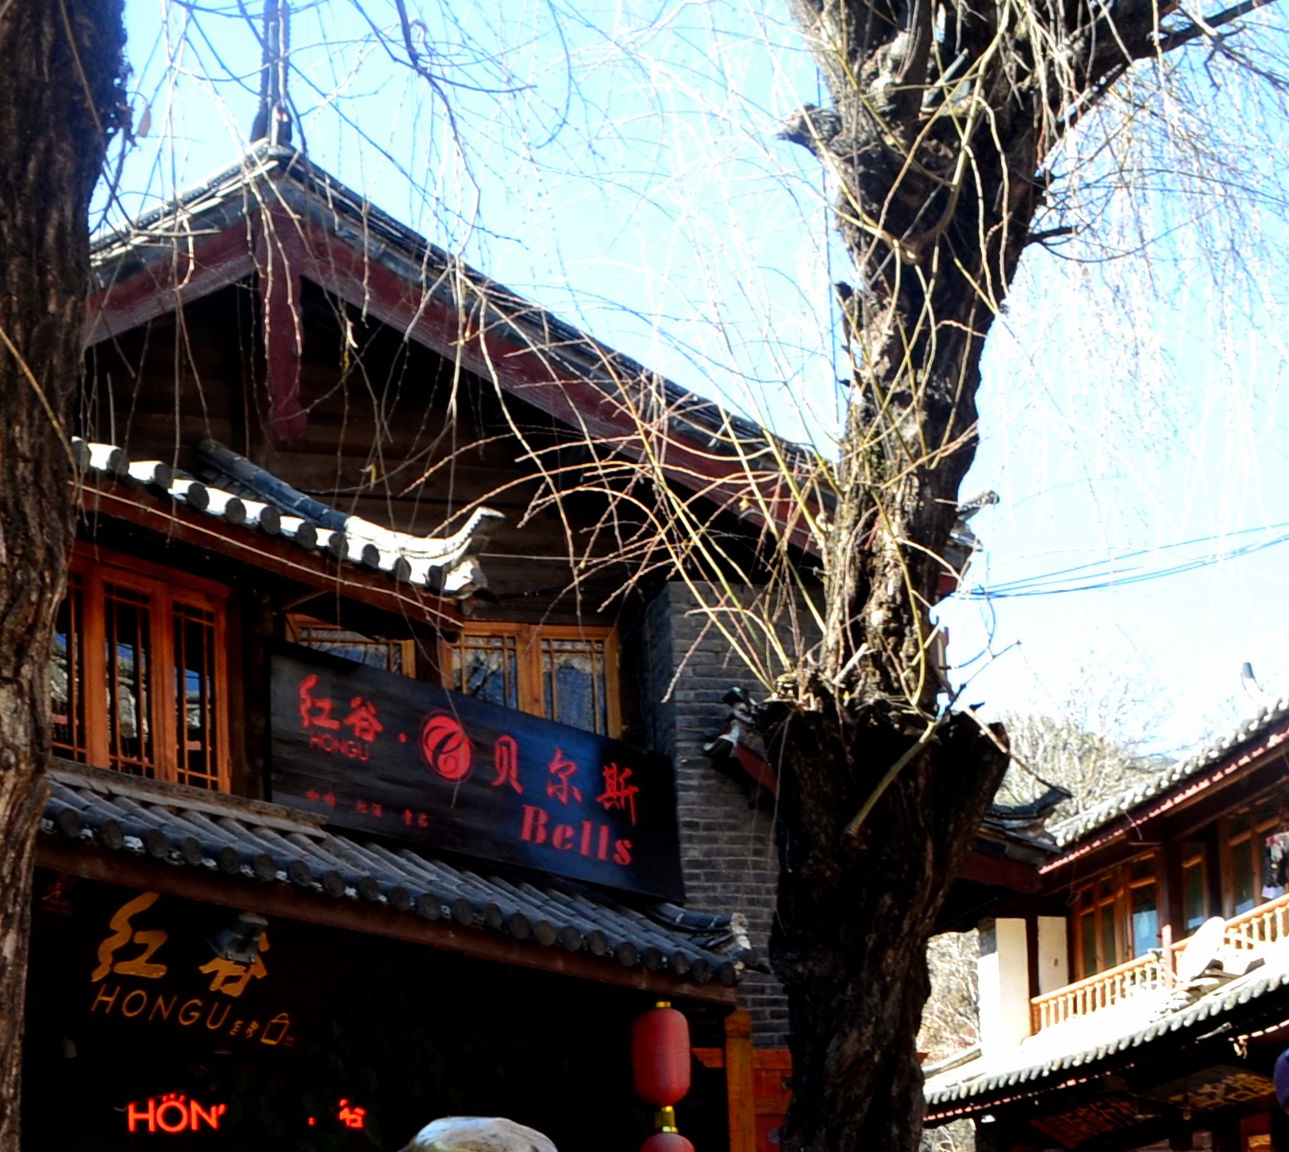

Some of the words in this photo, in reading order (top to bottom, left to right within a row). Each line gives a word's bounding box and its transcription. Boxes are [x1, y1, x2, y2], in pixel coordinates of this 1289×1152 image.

[296, 673, 384, 743] 红谷
[308, 732, 371, 763] HONGU
[491, 734, 640, 829] 贝尔斯
[519, 803, 634, 867] Bells
[90, 983, 232, 1031] HONGU
[128, 1099, 226, 1133] HON
